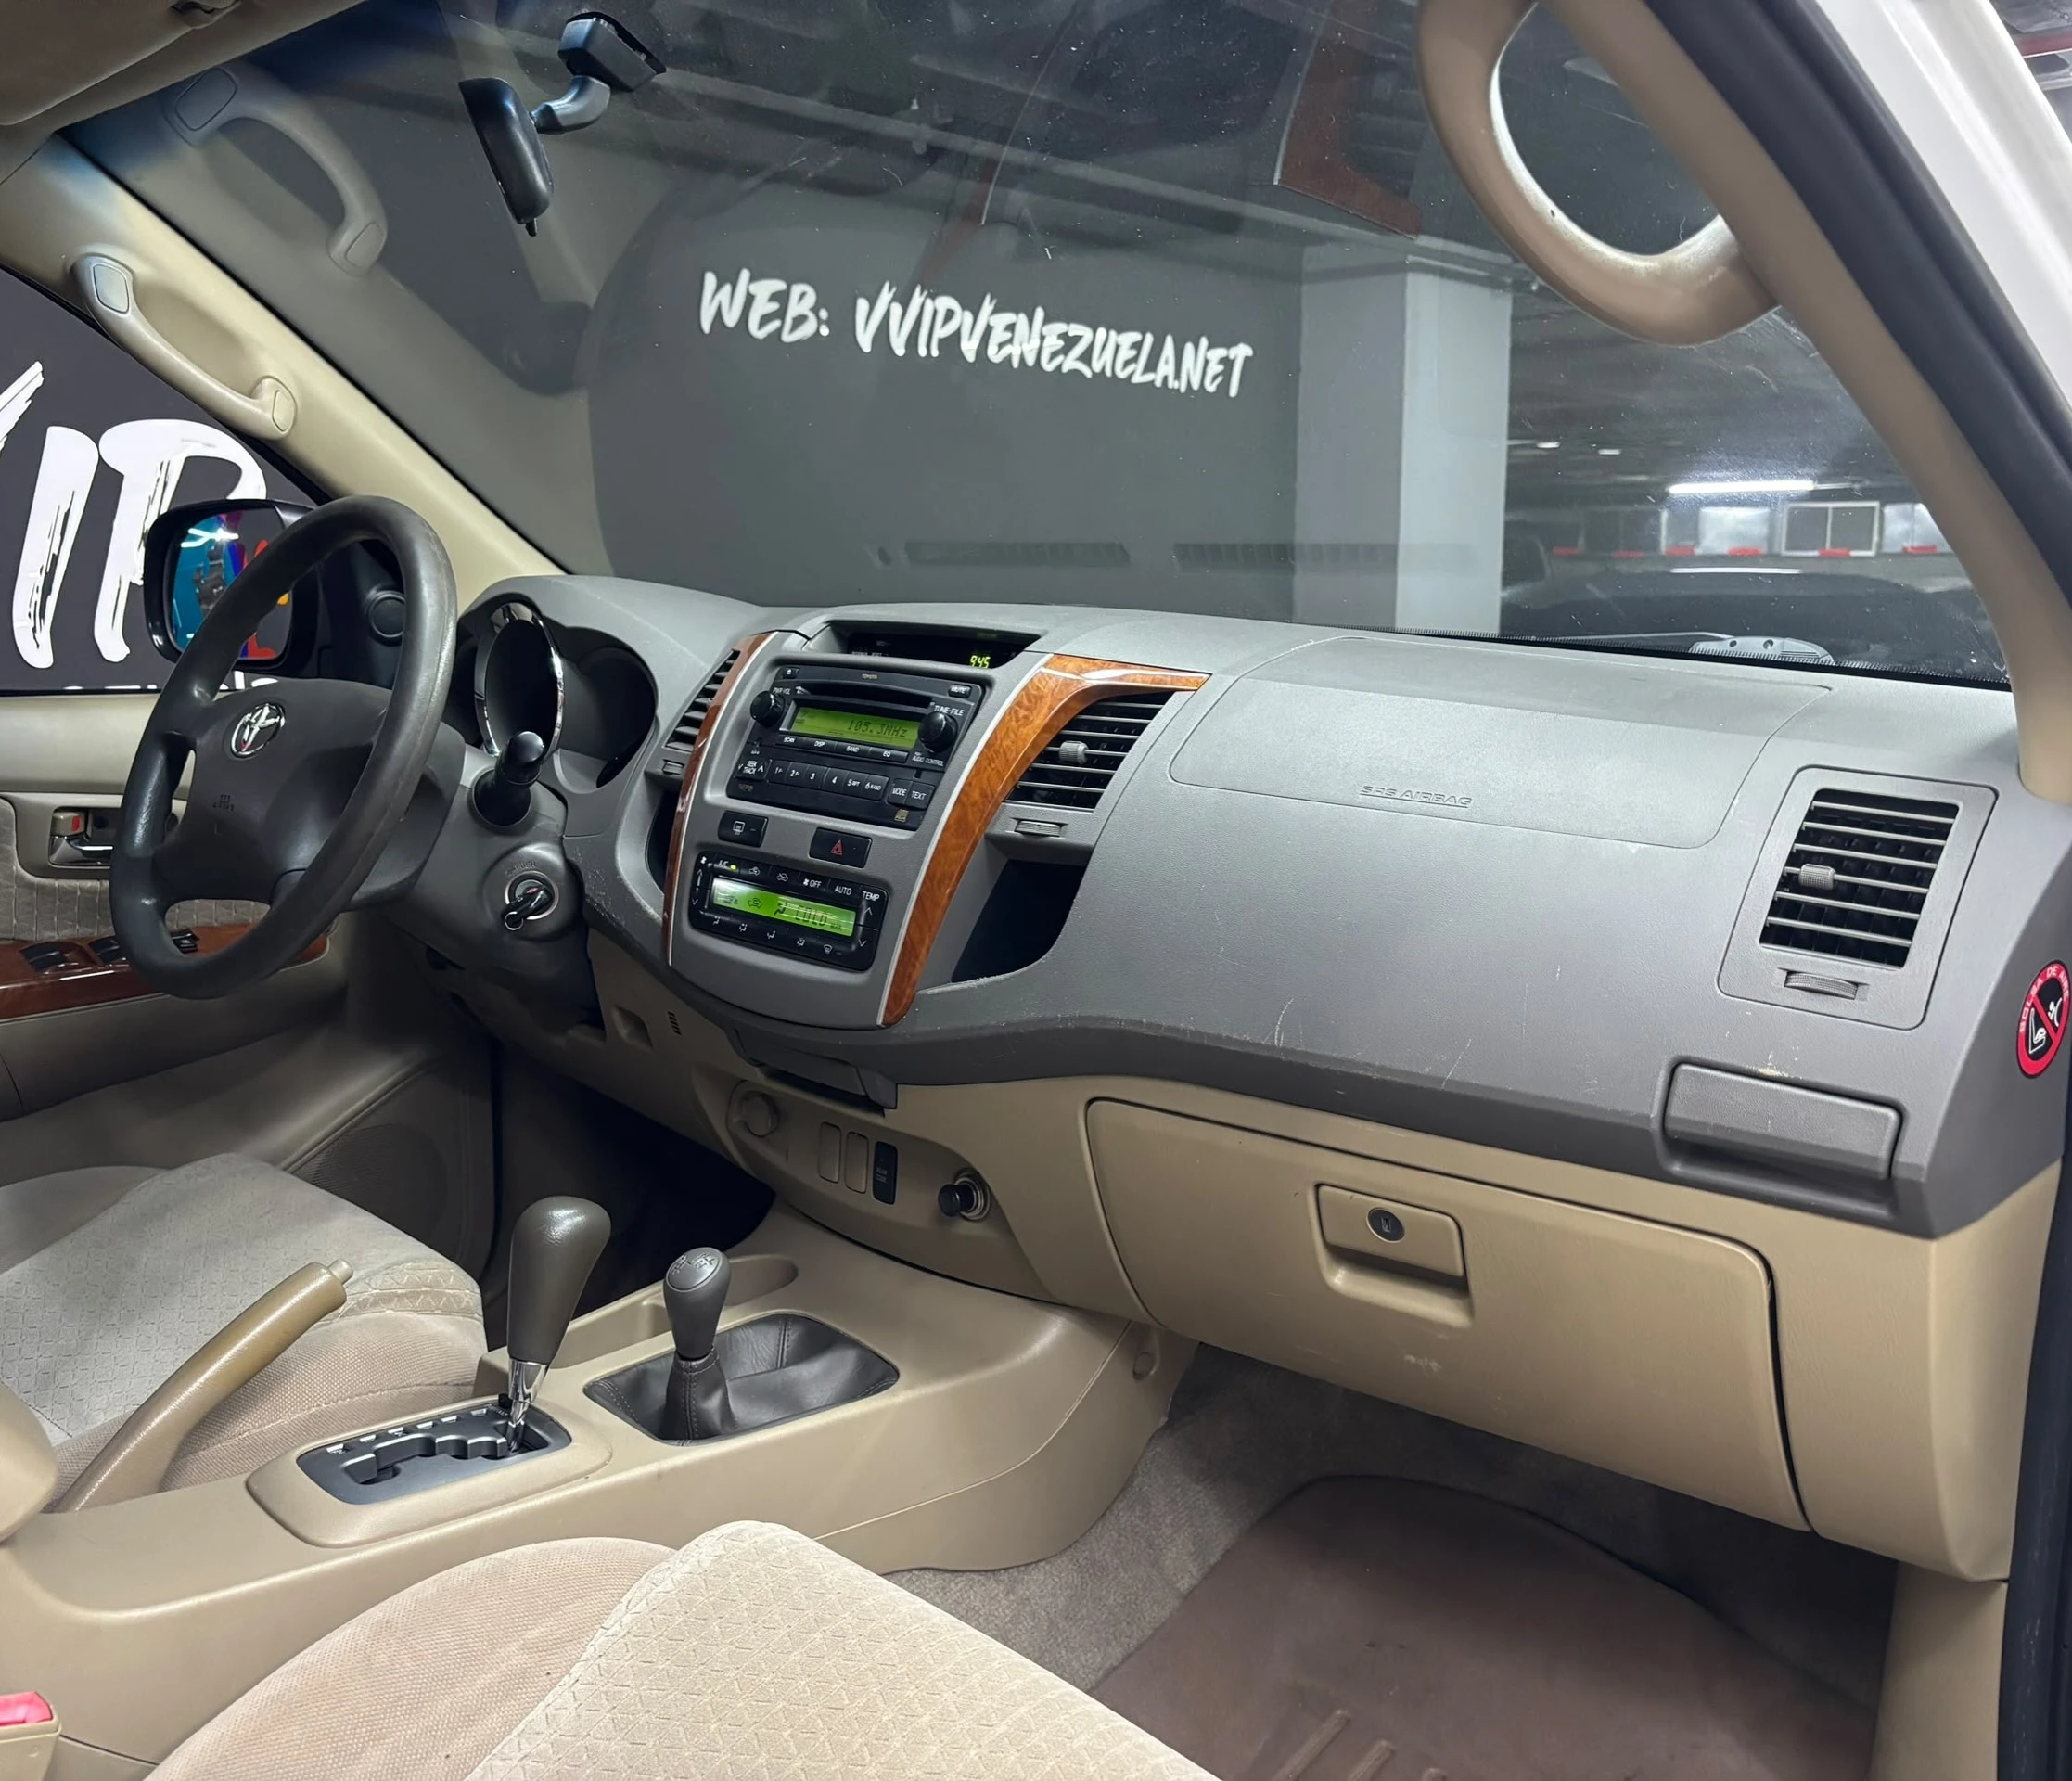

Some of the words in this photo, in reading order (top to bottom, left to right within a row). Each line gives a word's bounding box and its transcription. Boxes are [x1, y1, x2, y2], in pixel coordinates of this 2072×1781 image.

[700, 268, 829, 343] WEB:
[854, 280, 1253, 398] VVIPVENEZUELA.NET
[0, 361, 267, 669] IP
[846, 745, 860, 753] BAND
[891, 788, 907, 797] MODE
[911, 790, 927, 800] TEXT
[1360, 785, 1397, 798] SRS
[1399, 789, 1473, 806] AIRBAG
[809, 879, 822, 889] OFF
[834, 885, 852, 896] AUTO
[862, 890, 880, 902] TEMP
[2046, 965, 2059, 978] DE
